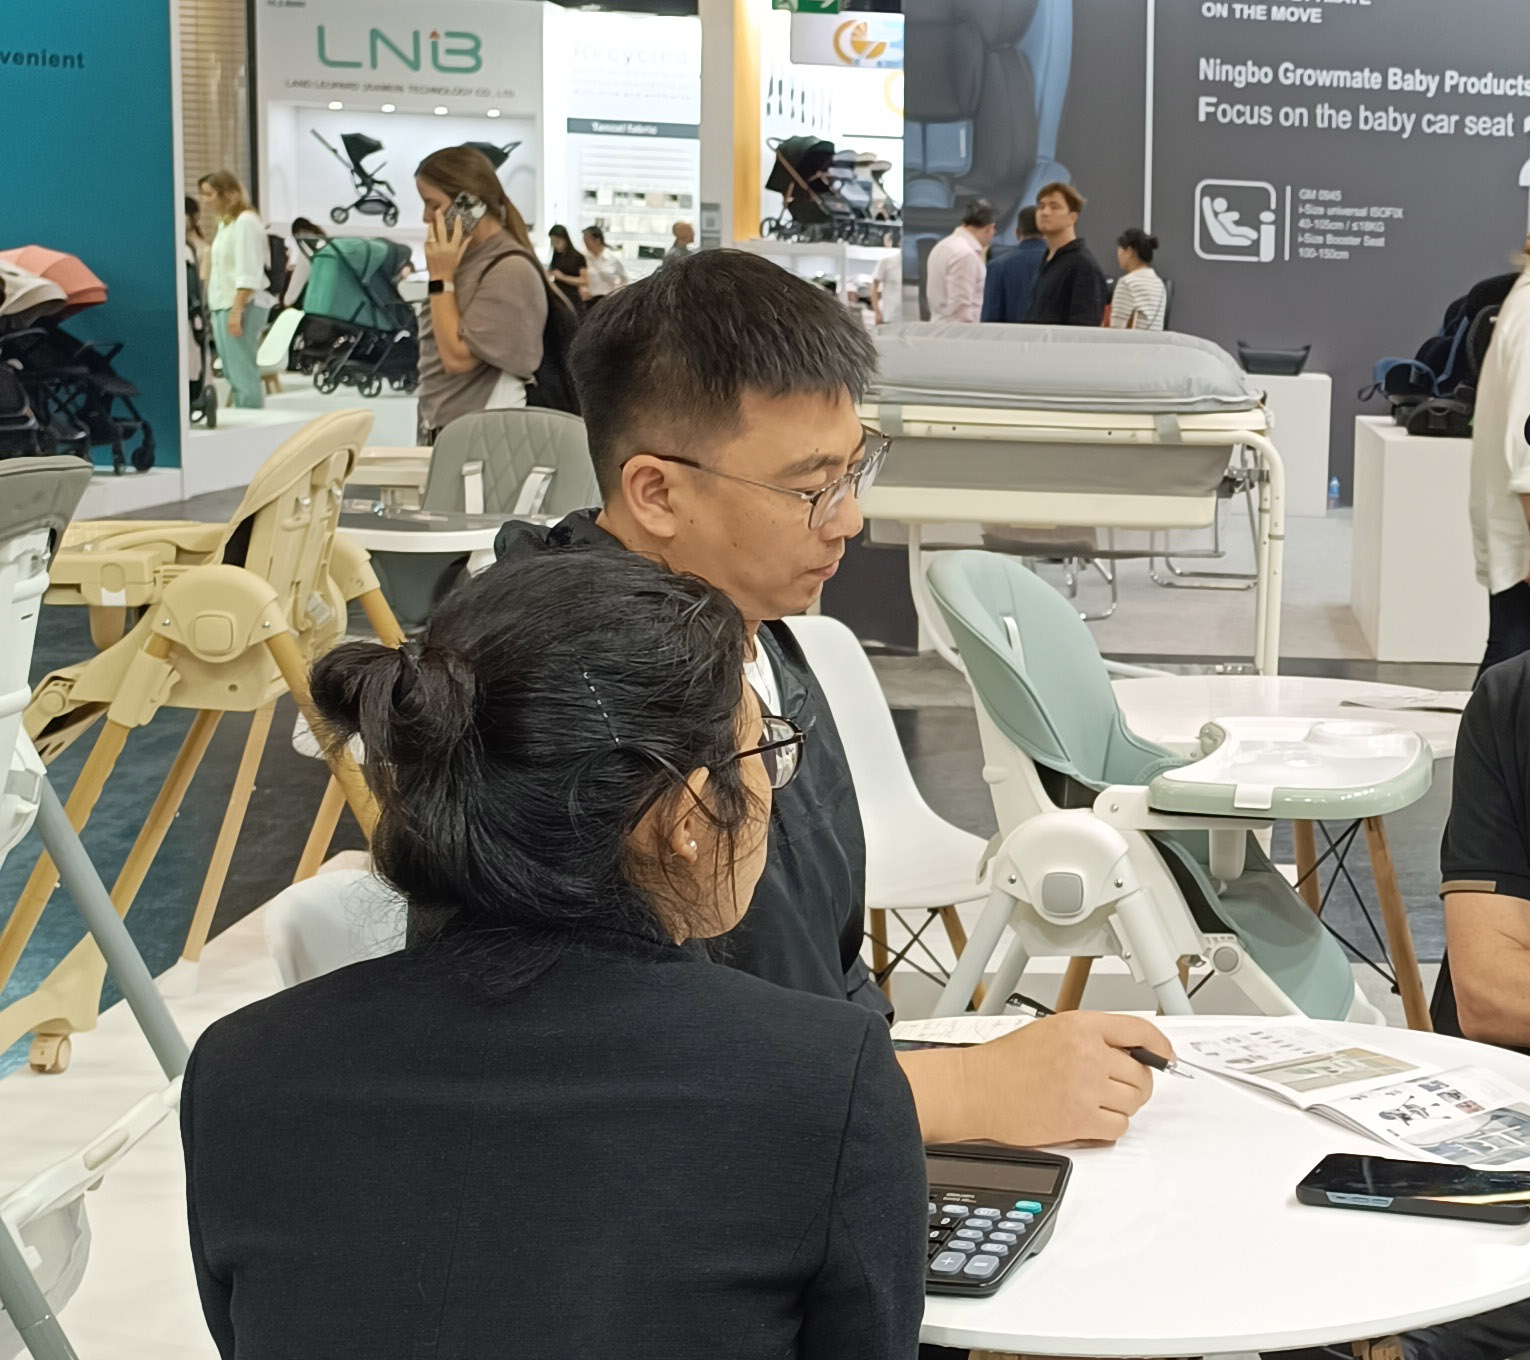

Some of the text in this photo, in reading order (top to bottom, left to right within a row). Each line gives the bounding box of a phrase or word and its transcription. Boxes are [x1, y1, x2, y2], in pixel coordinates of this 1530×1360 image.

[1201, 2, 1322, 24] ON THE MOVE
[1199, 58, 1274, 88] Ningbo
[1278, 62, 1382, 90] Growmate
[1387, 67, 1439, 98] Baby
[1198, 96, 1515, 139] Focus on the baby car seat
